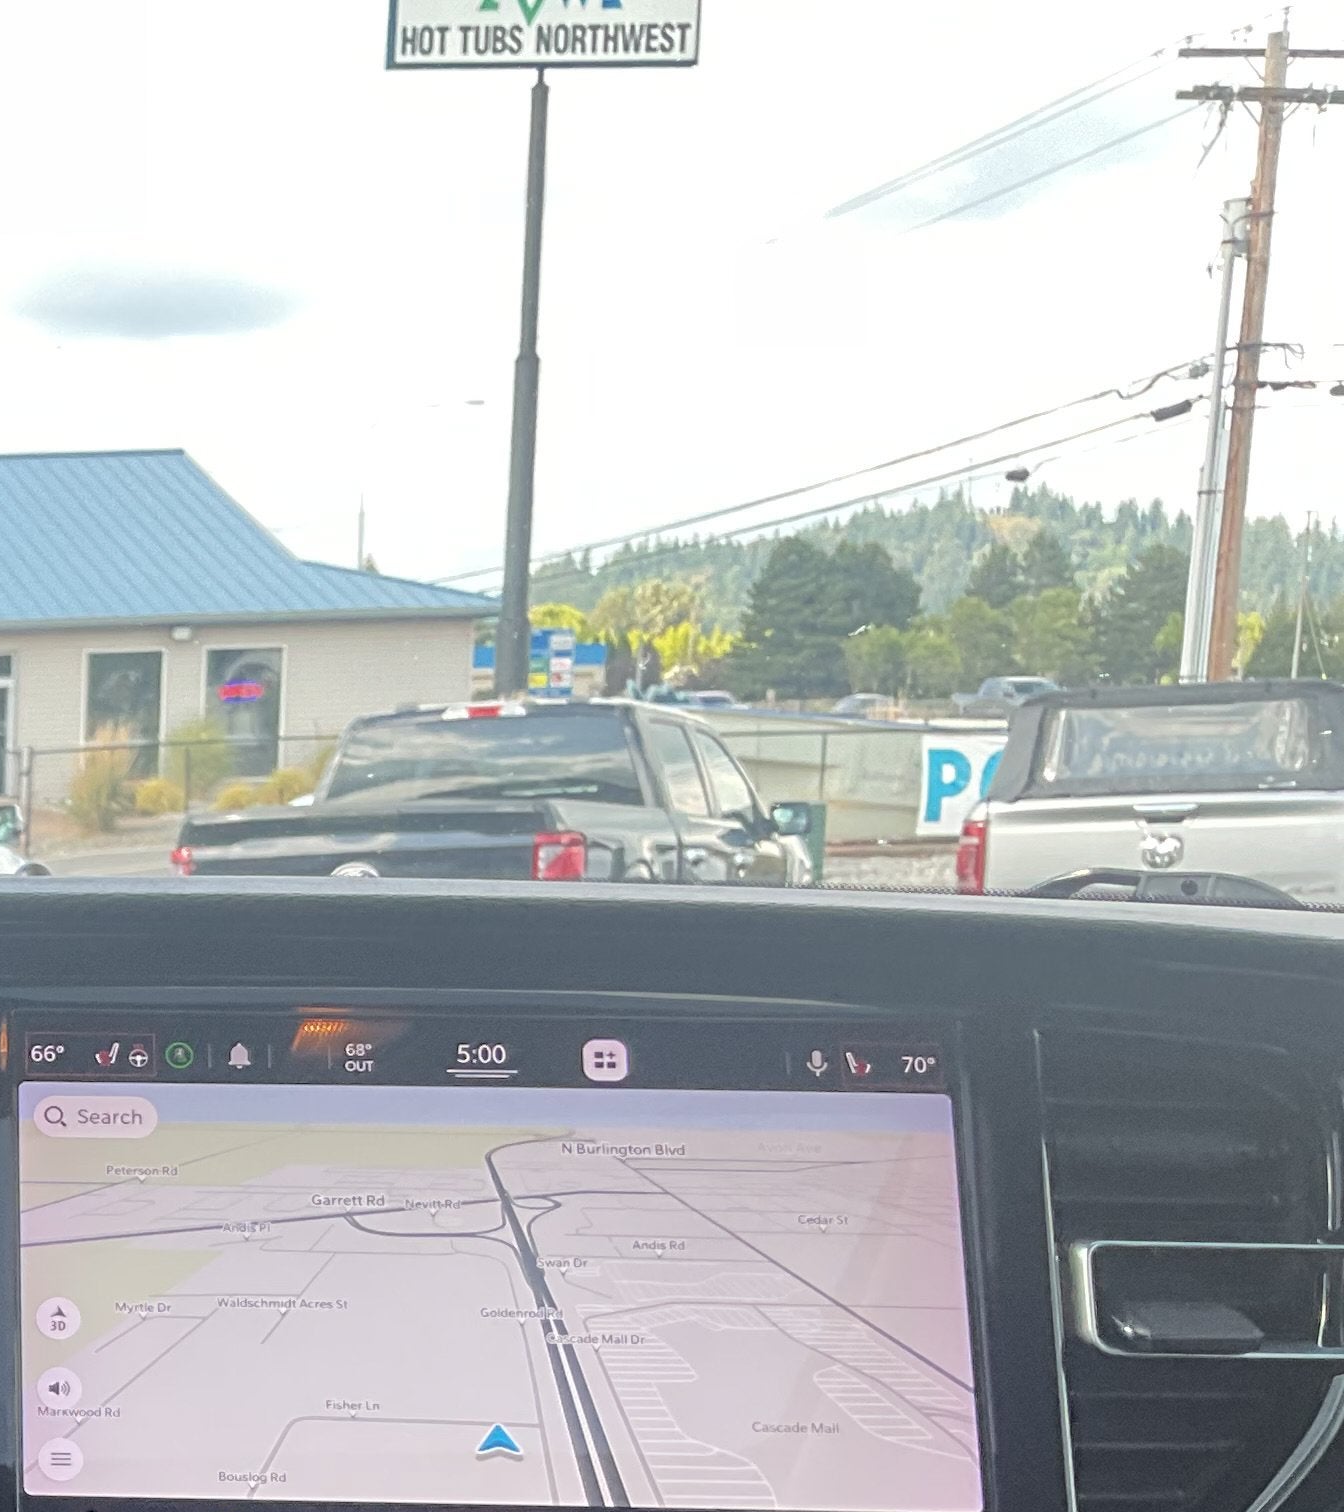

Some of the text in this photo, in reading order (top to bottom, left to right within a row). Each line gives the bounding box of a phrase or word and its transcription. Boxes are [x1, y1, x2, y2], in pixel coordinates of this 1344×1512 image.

[401, 22, 693, 56] HOT TUBS NORTHWEST
[924, 749, 1004, 822] P
[29, 1044, 65, 1064] 66°
[344, 1042, 374, 1058] 68°
[455, 1043, 507, 1065] 5:00
[344, 1060, 375, 1073] OUT
[900, 1055, 937, 1075] 70°
[76, 1107, 144, 1126] Search
[562, 1142, 686, 1160] N Burlington Blvd
[105, 1164, 178, 1177] Peterson Rd
[312, 1193, 386, 1208] Garrett Rd
[443, 1197, 461, 1210] Rd
[798, 1213, 849, 1226] Cedar St
[632, 1239, 686, 1252] Andis Rd
[537, 1257, 588, 1268] Swan Dr
[115, 1301, 172, 1317] Myrtle Dr
[217, 1298, 348, 1312] Waldschmidt Acres St
[50, 1320, 66, 1331] 3D
[547, 1333, 644, 1345] Cascade Mall Dr
[103, 1406, 121, 1418] Rd
[326, 1400, 380, 1411] Fisher Ln
[751, 1420, 840, 1434] Cascade Mall
[271, 1472, 287, 1484] Rd
